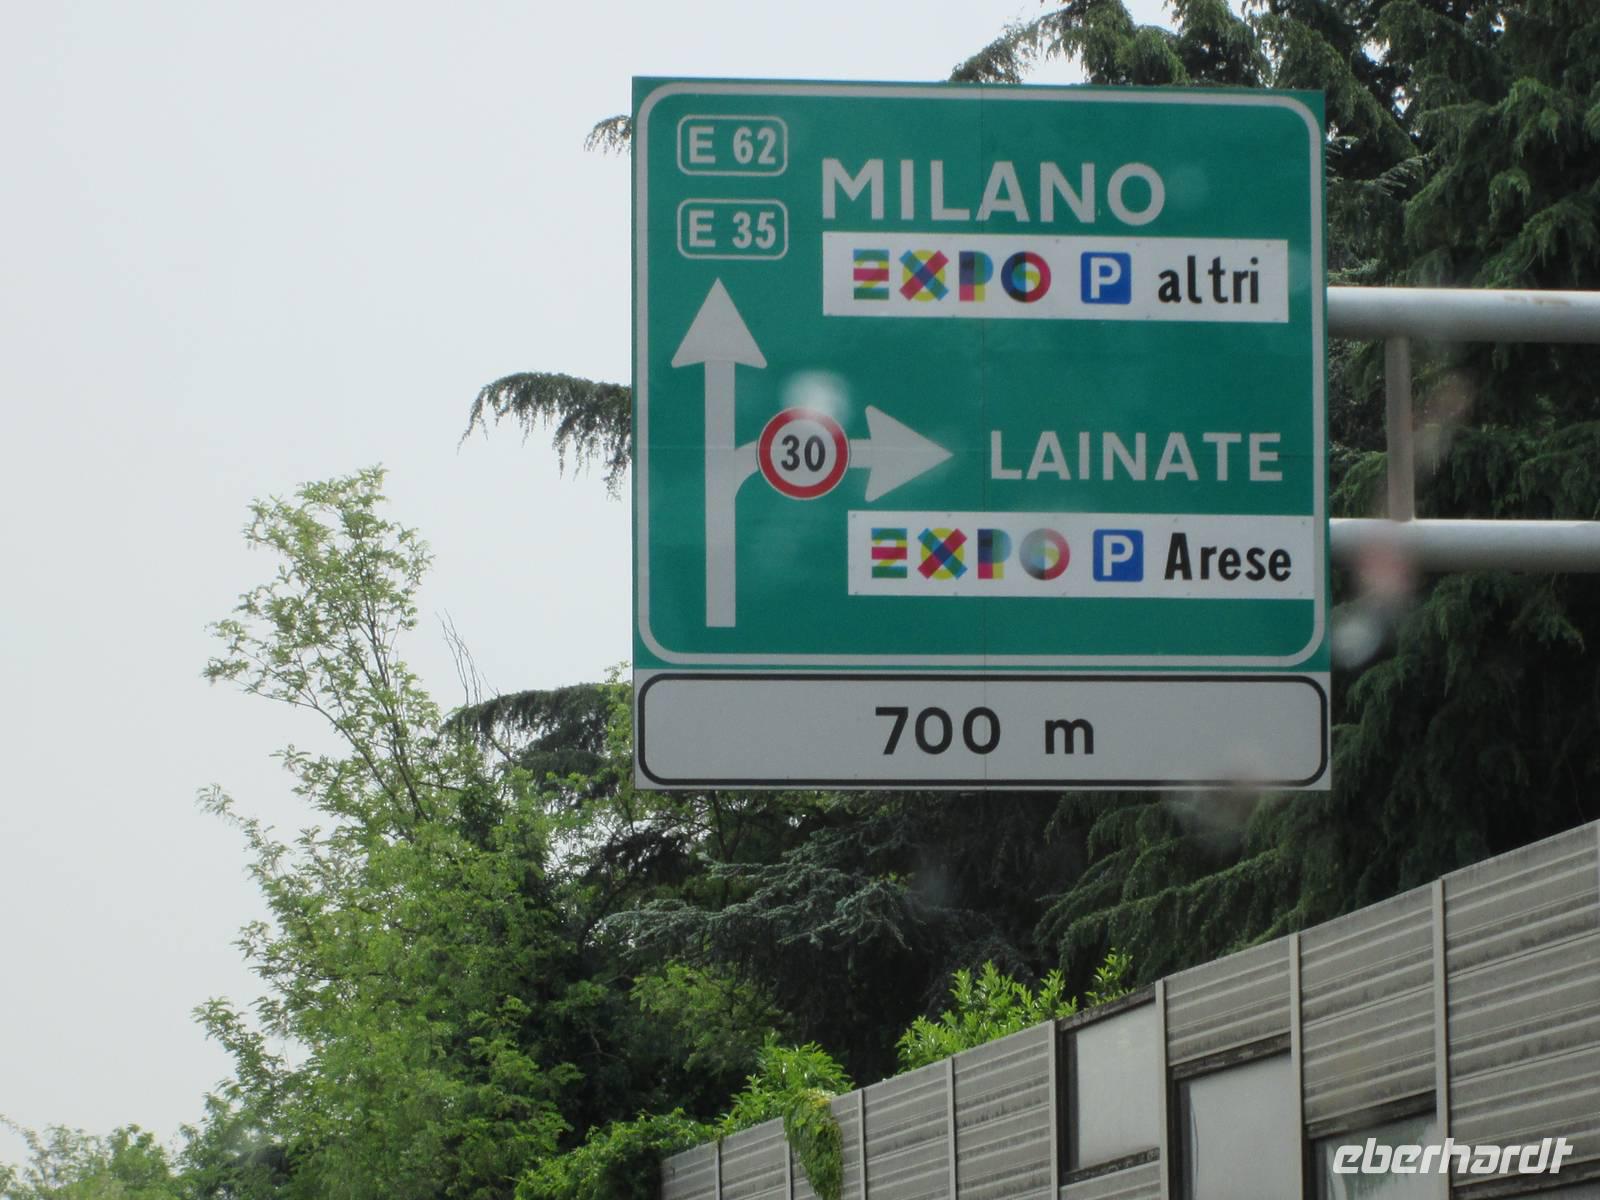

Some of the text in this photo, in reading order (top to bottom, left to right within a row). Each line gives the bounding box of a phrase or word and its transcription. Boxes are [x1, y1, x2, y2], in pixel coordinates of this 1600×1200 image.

[688, 126, 777, 165] E 62
[822, 157, 1166, 226] MILANO
[688, 209, 777, 249] E 35
[853, 249, 1260, 304] EXPO P altri
[780, 434, 826, 473] 30
[991, 430, 1284, 482] LAINATE
[871, 528, 1293, 582] EXPO P Arese
[875, 706, 1095, 756] 700 m
